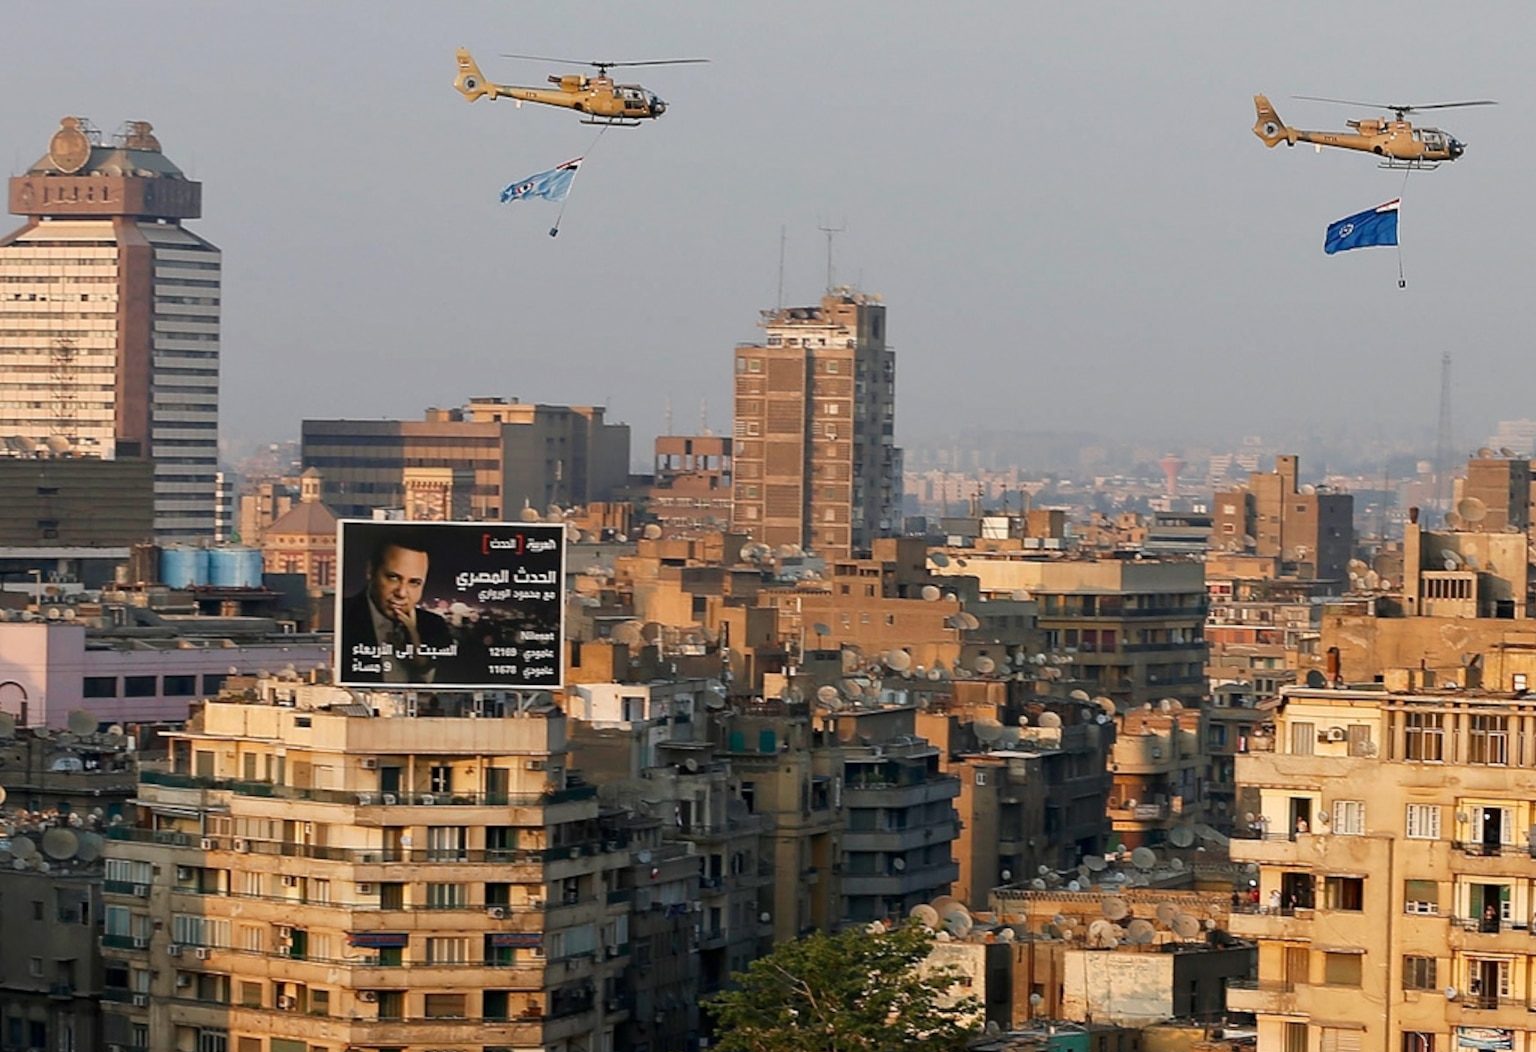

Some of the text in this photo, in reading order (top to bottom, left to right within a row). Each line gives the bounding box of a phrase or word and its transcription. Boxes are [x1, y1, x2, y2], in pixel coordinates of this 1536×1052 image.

[526, 538, 557, 553] العربية
[455, 566, 557, 591] الحدث المصري
[513, 590, 541, 601] محمود
[542, 591, 556, 601] مع
[520, 630, 555, 641] Nilesat
[395, 644, 414, 660] إلى
[415, 639, 459, 660] السبت
[383, 661, 393, 672] 9
